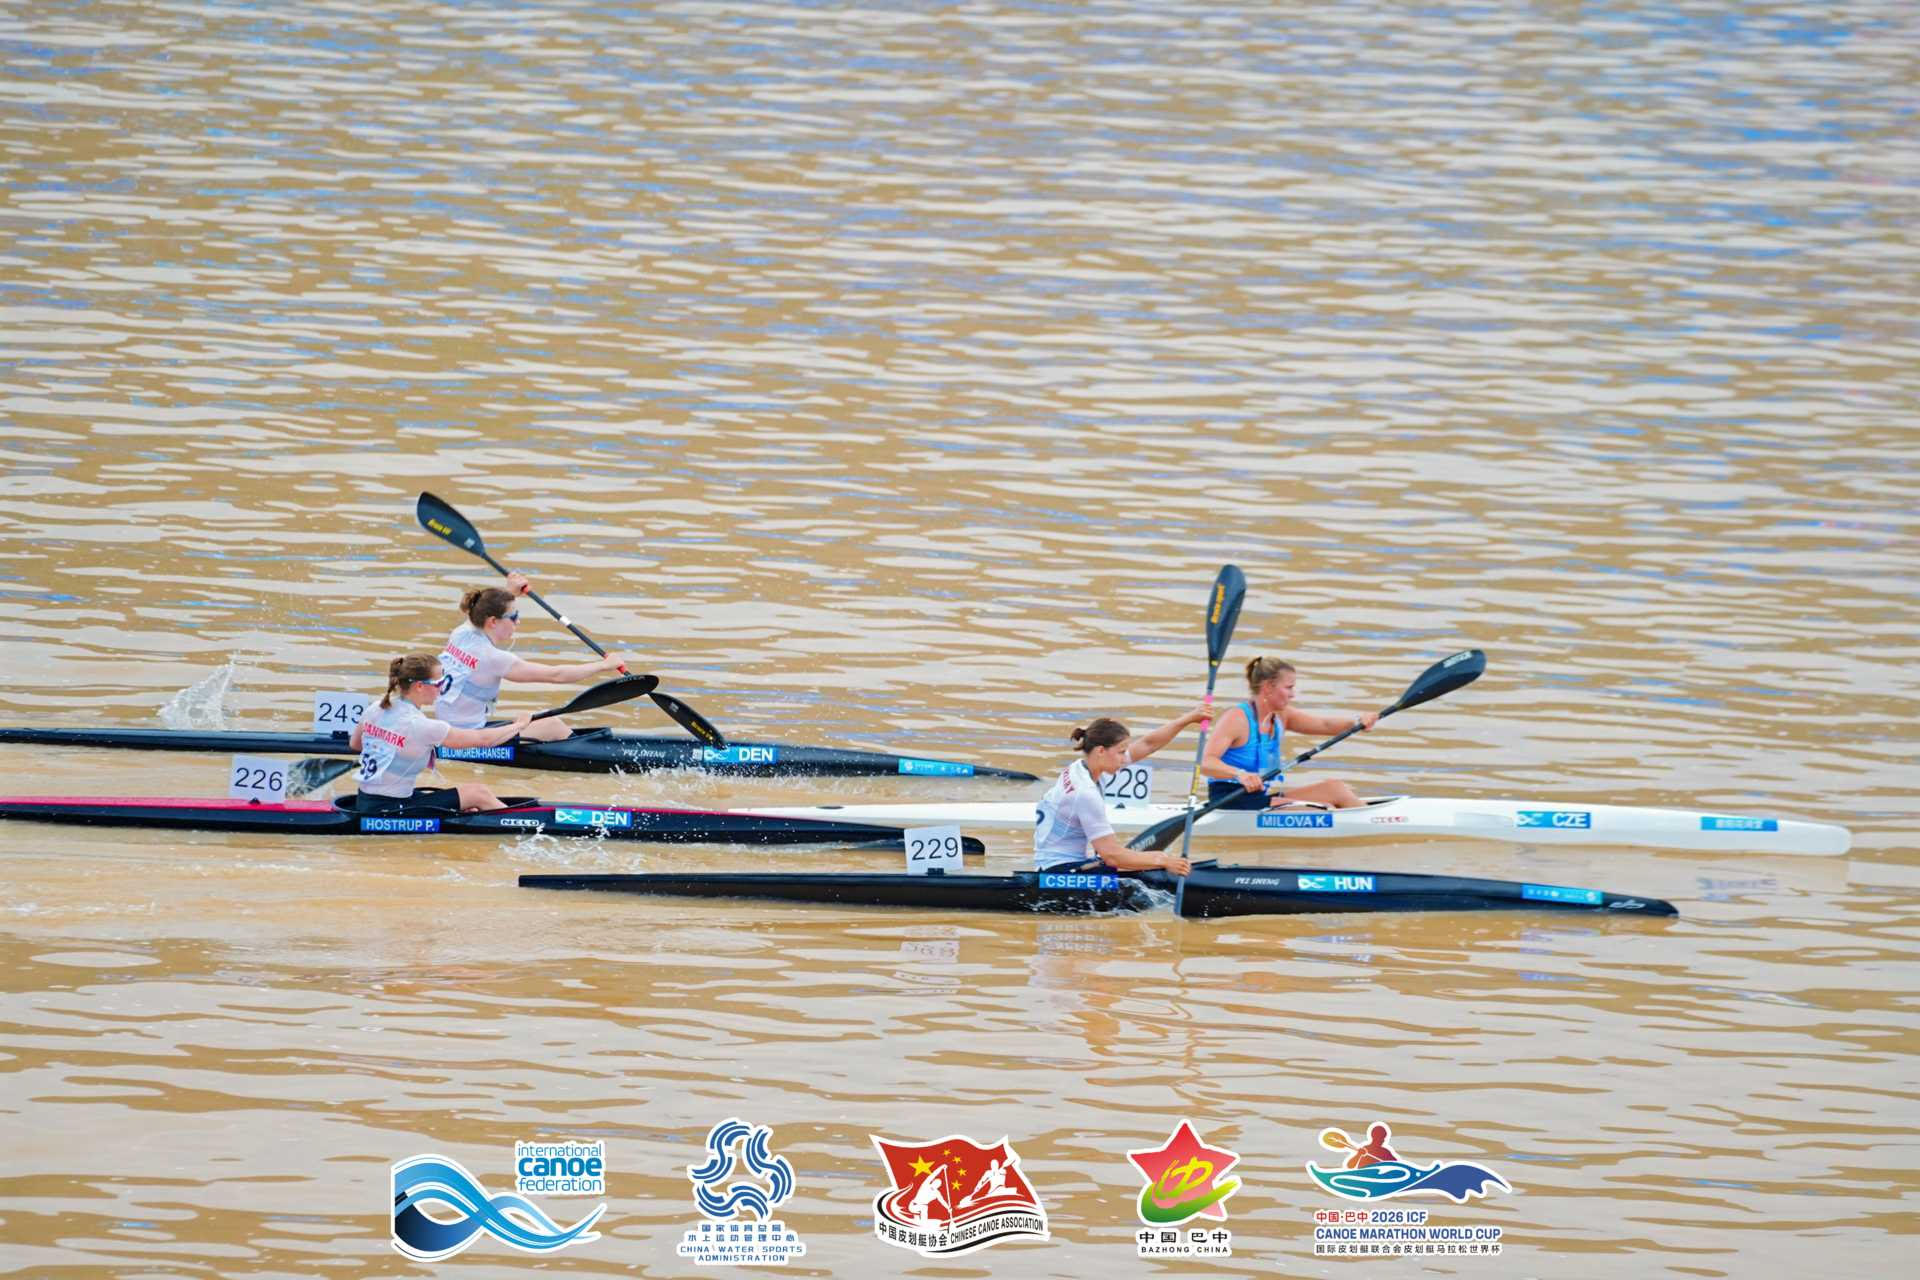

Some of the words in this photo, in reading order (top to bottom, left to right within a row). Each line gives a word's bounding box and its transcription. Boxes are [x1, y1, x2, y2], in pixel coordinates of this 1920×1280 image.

[318, 702, 364, 724] 243
[738, 748, 773, 762] DEN
[234, 767, 284, 792] 226
[1104, 767, 1149, 800] 228
[366, 819, 422, 832] HOSTRUP
[425, 820, 436, 832] P.
[591, 810, 628, 826] DEN
[1262, 815, 1313, 827] MILOVA
[1316, 815, 1329, 827] K.
[1552, 812, 1588, 827] CZE
[911, 836, 959, 861] 229
[1046, 875, 1097, 888] CSEPE
[1101, 876, 1113, 888] P.
[1334, 876, 1373, 890] HUN
